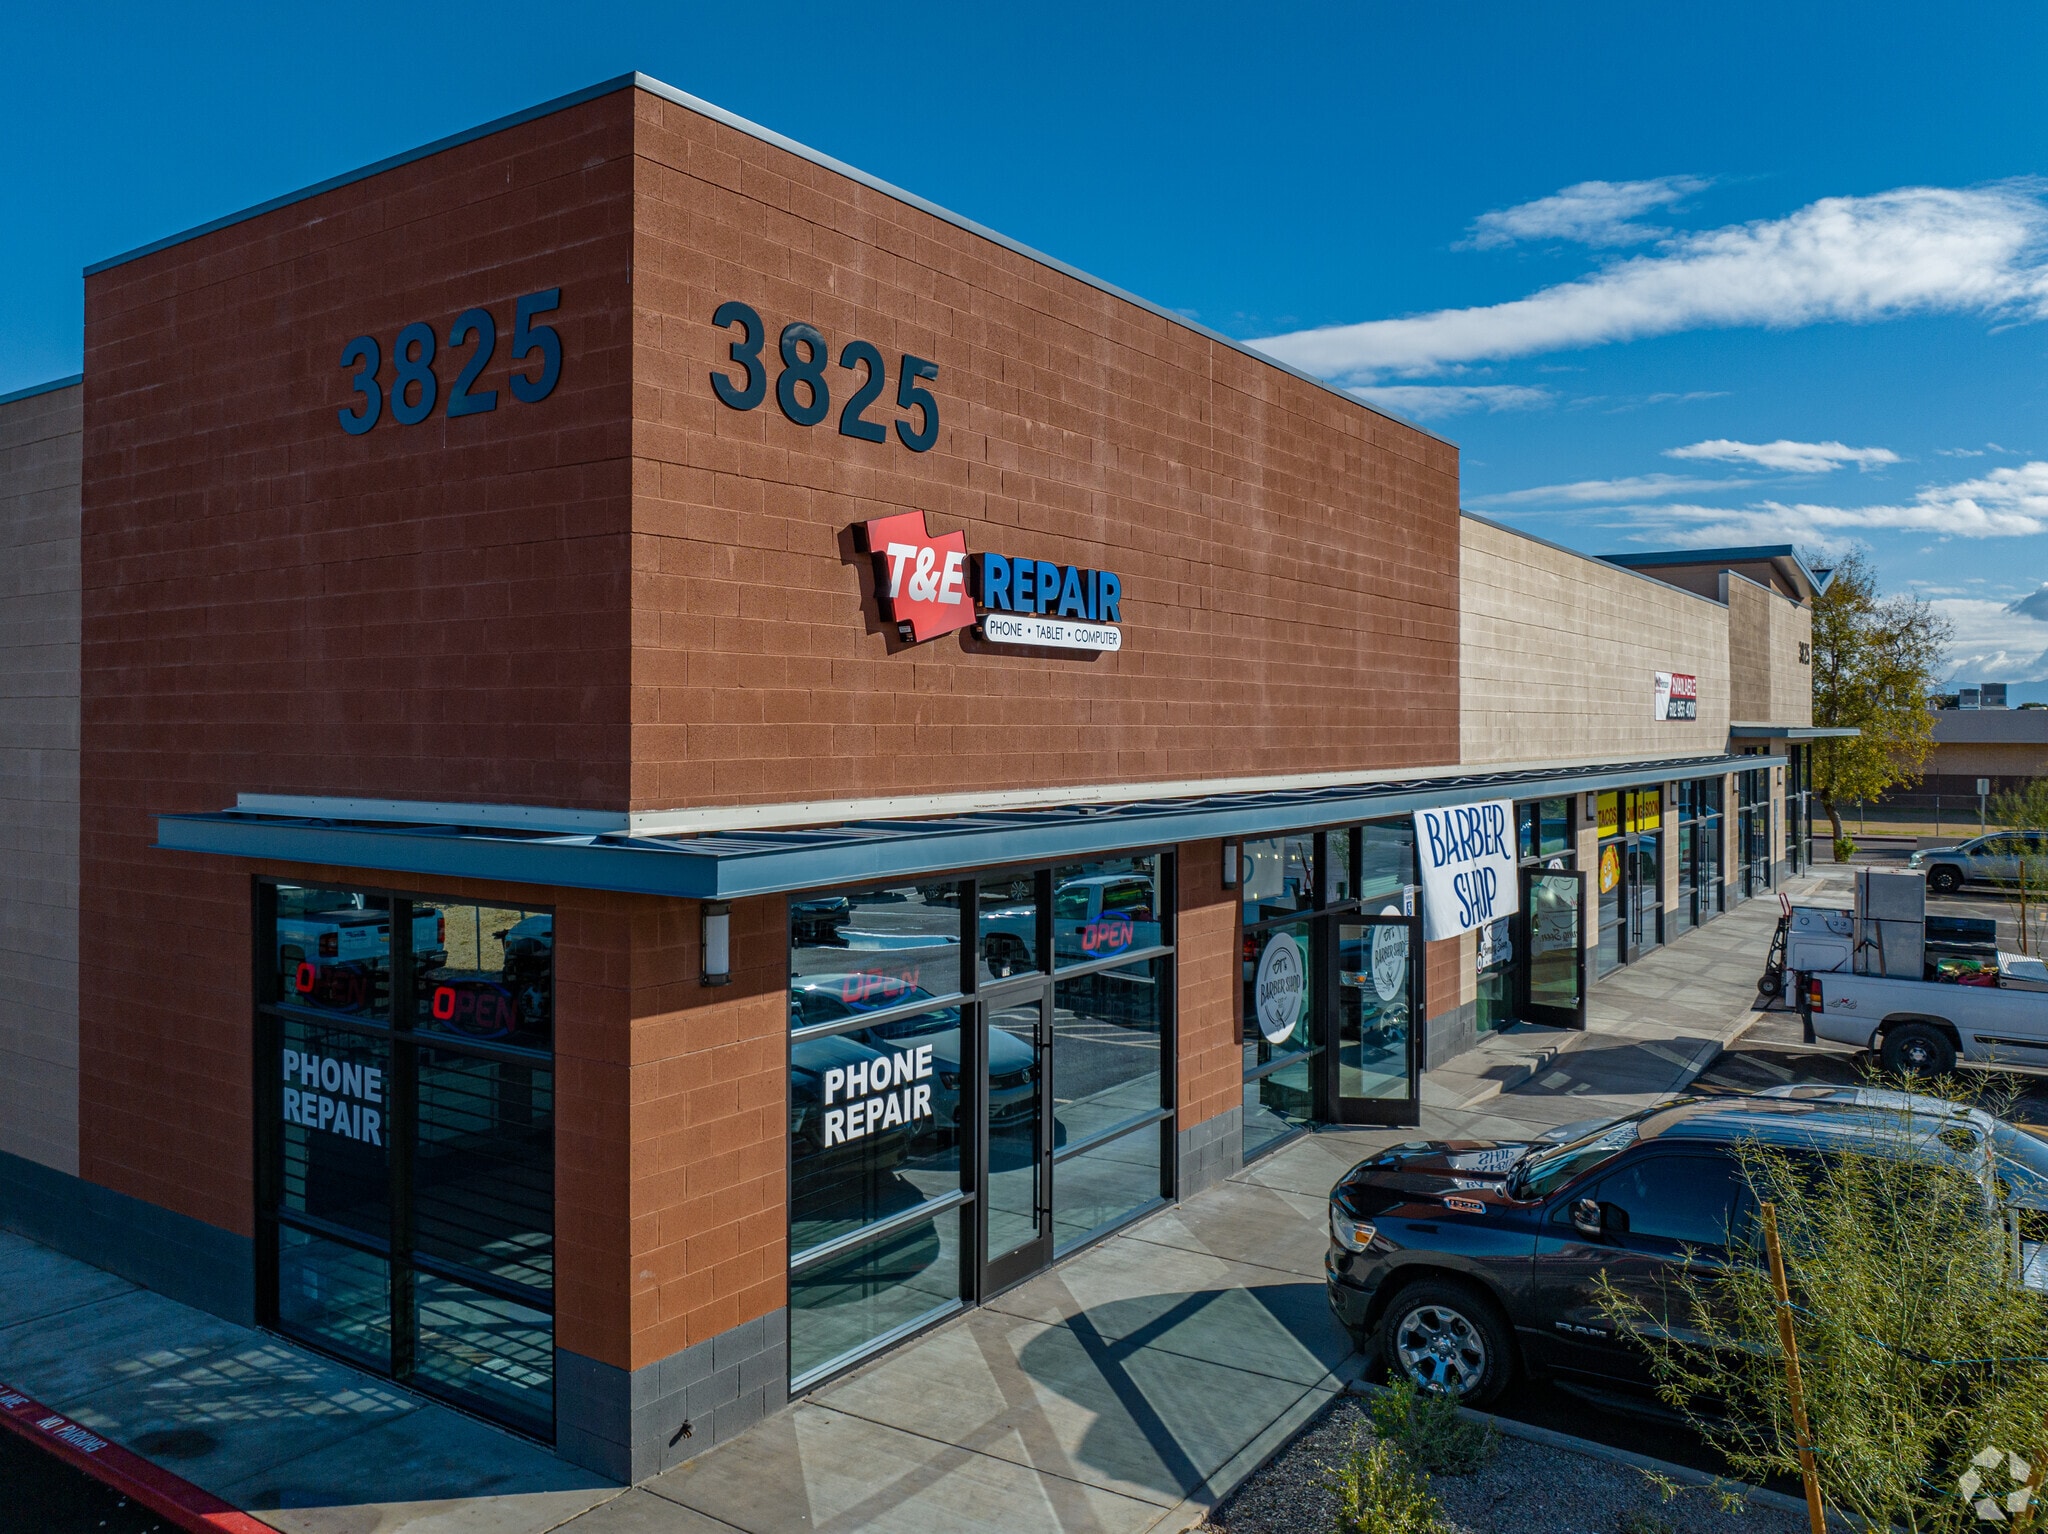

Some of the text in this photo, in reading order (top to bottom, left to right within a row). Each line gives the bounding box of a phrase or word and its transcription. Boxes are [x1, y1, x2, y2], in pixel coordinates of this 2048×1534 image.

[337, 287, 561, 436] 3825
[710, 301, 940, 453] 3825
[887, 542, 1122, 622] T&E REPAIR
[990, 621, 1118, 645] PHONE TABLET COMPUTER
[1424, 804, 1511, 868] BARBER
[1598, 806, 1617, 826] TACOS
[1453, 866, 1497, 928] SHOP
[1081, 920, 1133, 951] OPEN
[296, 962, 367, 1008] OPEN
[433, 986, 518, 1033] OPEN
[842, 965, 920, 1003] OPEN
[1261, 974, 1301, 1006] BARBER SHOP
[283, 1048, 382, 1104] PHONE
[825, 1044, 933, 1106] PHONE
[283, 1087, 382, 1147] REPAIR
[824, 1084, 933, 1148] REPAIR
[1555, 1321, 1607, 1337] RAM
[36, 1415, 65, 1430] NO
[53, 1424, 108, 1453] PARKING
